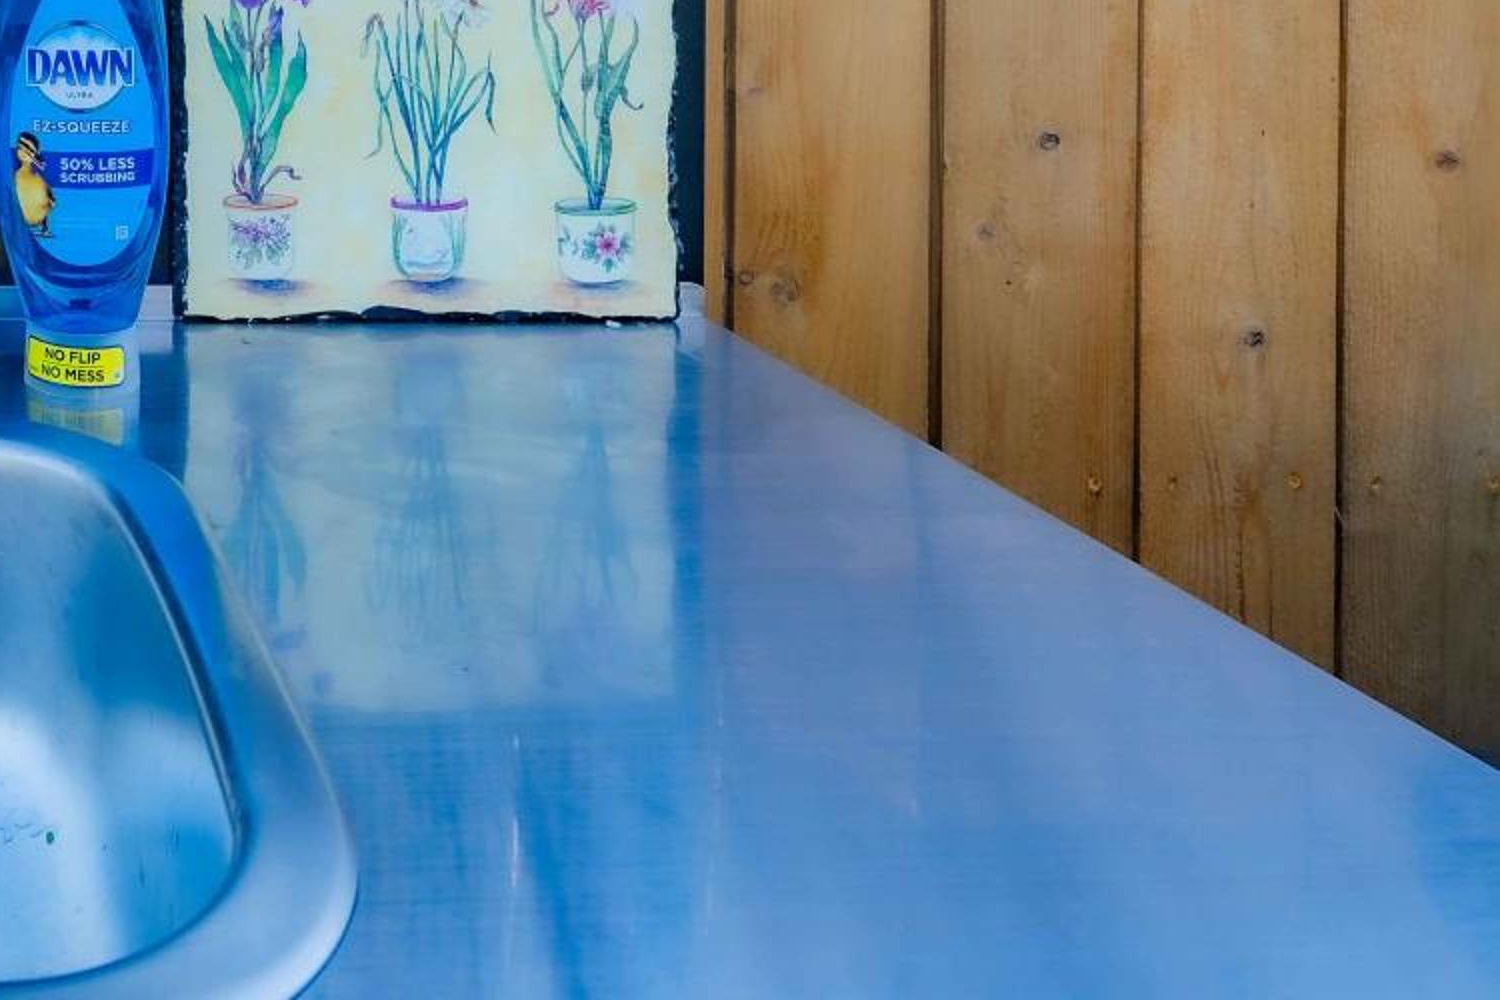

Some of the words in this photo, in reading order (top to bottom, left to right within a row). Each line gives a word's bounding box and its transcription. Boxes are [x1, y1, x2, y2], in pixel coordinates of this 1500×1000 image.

[26, 48, 134, 86] DAWN
[32, 119, 132, 134] EZ-SQUEEZE
[60, 157, 95, 171] 50%
[99, 156, 136, 170] LESS
[60, 171, 136, 183] SCRUBBING
[45, 347, 65, 362] NO
[69, 350, 101, 364] FLIP
[41, 363, 61, 379] NO
[65, 368, 105, 383] MESS
